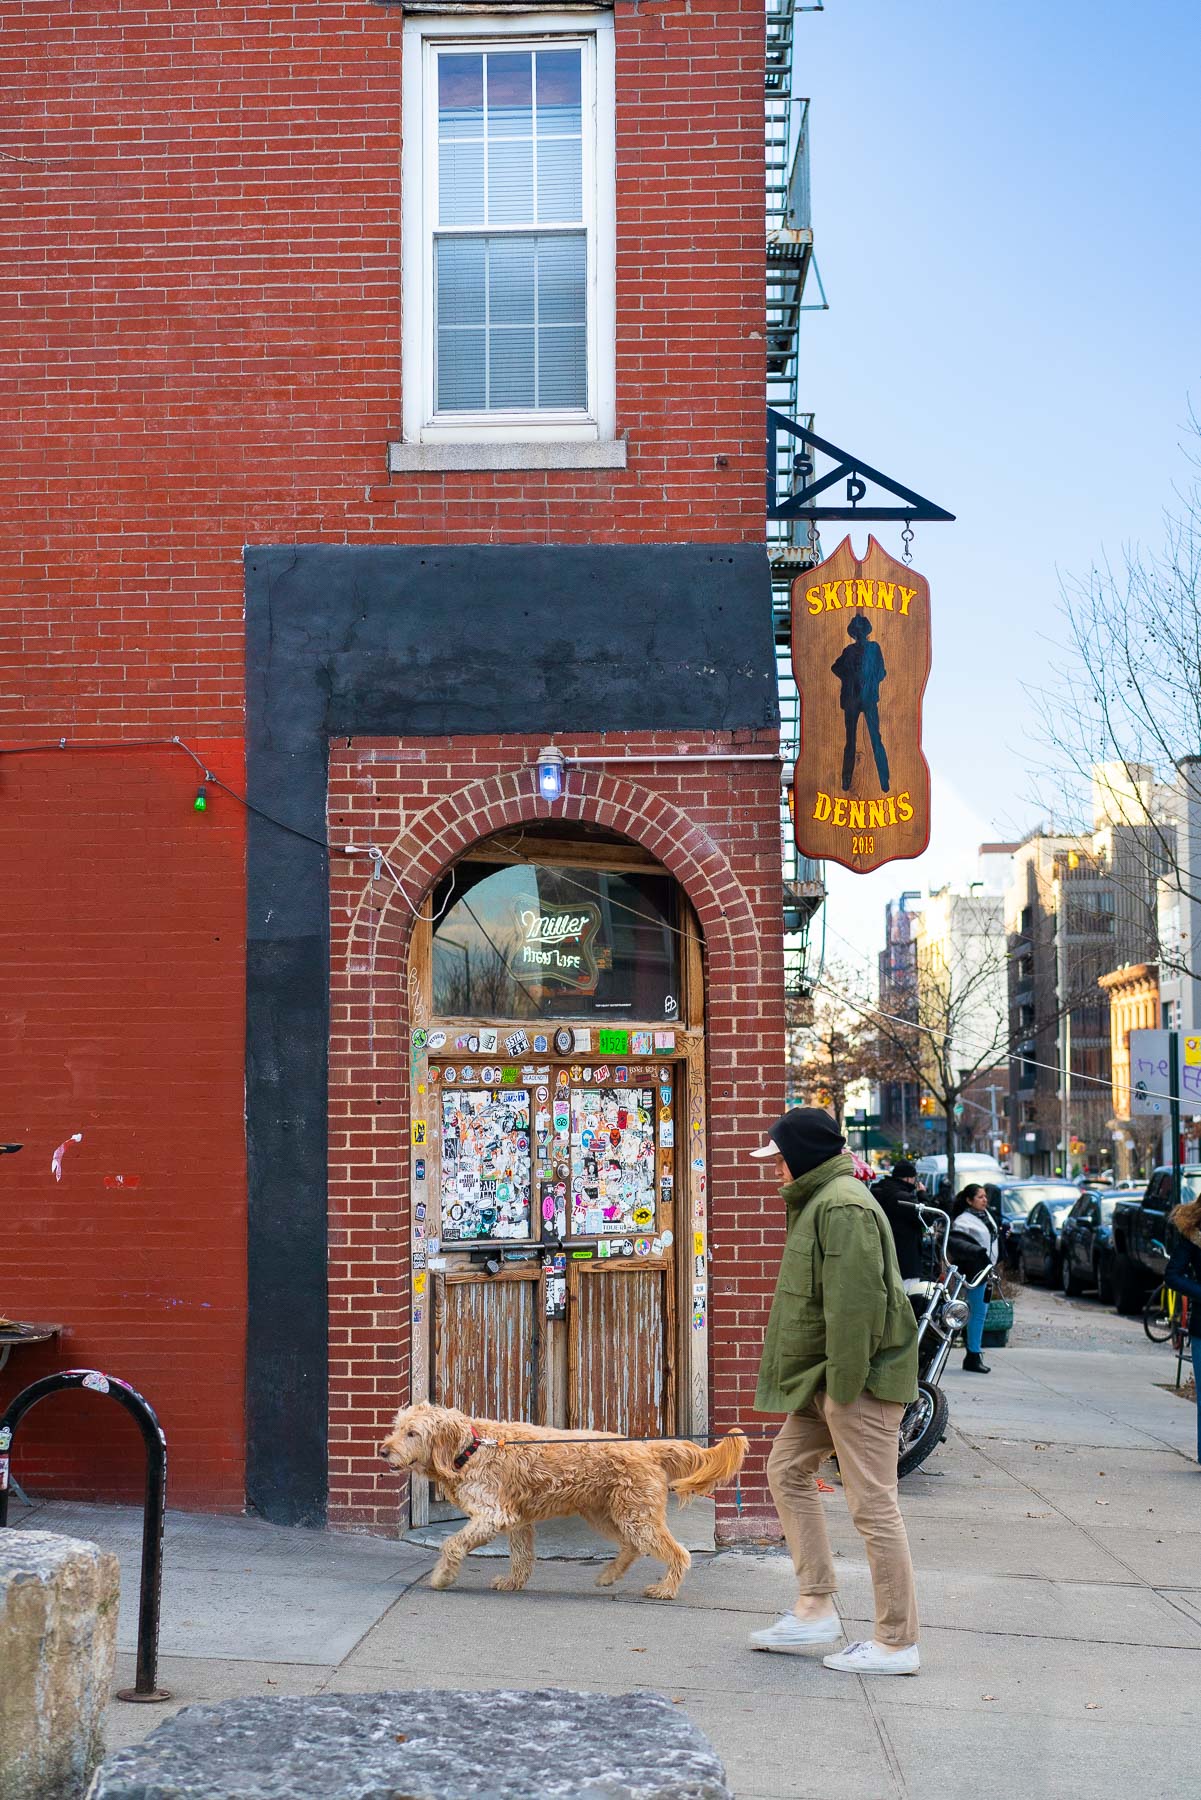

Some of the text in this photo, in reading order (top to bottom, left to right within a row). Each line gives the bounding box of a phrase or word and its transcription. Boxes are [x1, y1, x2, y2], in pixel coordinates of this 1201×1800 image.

[847, 479, 866, 501] D
[805, 579, 918, 616] SKINNY
[812, 791, 914, 829] DENNIS
[852, 836, 875, 854] 2013
[520, 910, 590, 938] Miller
